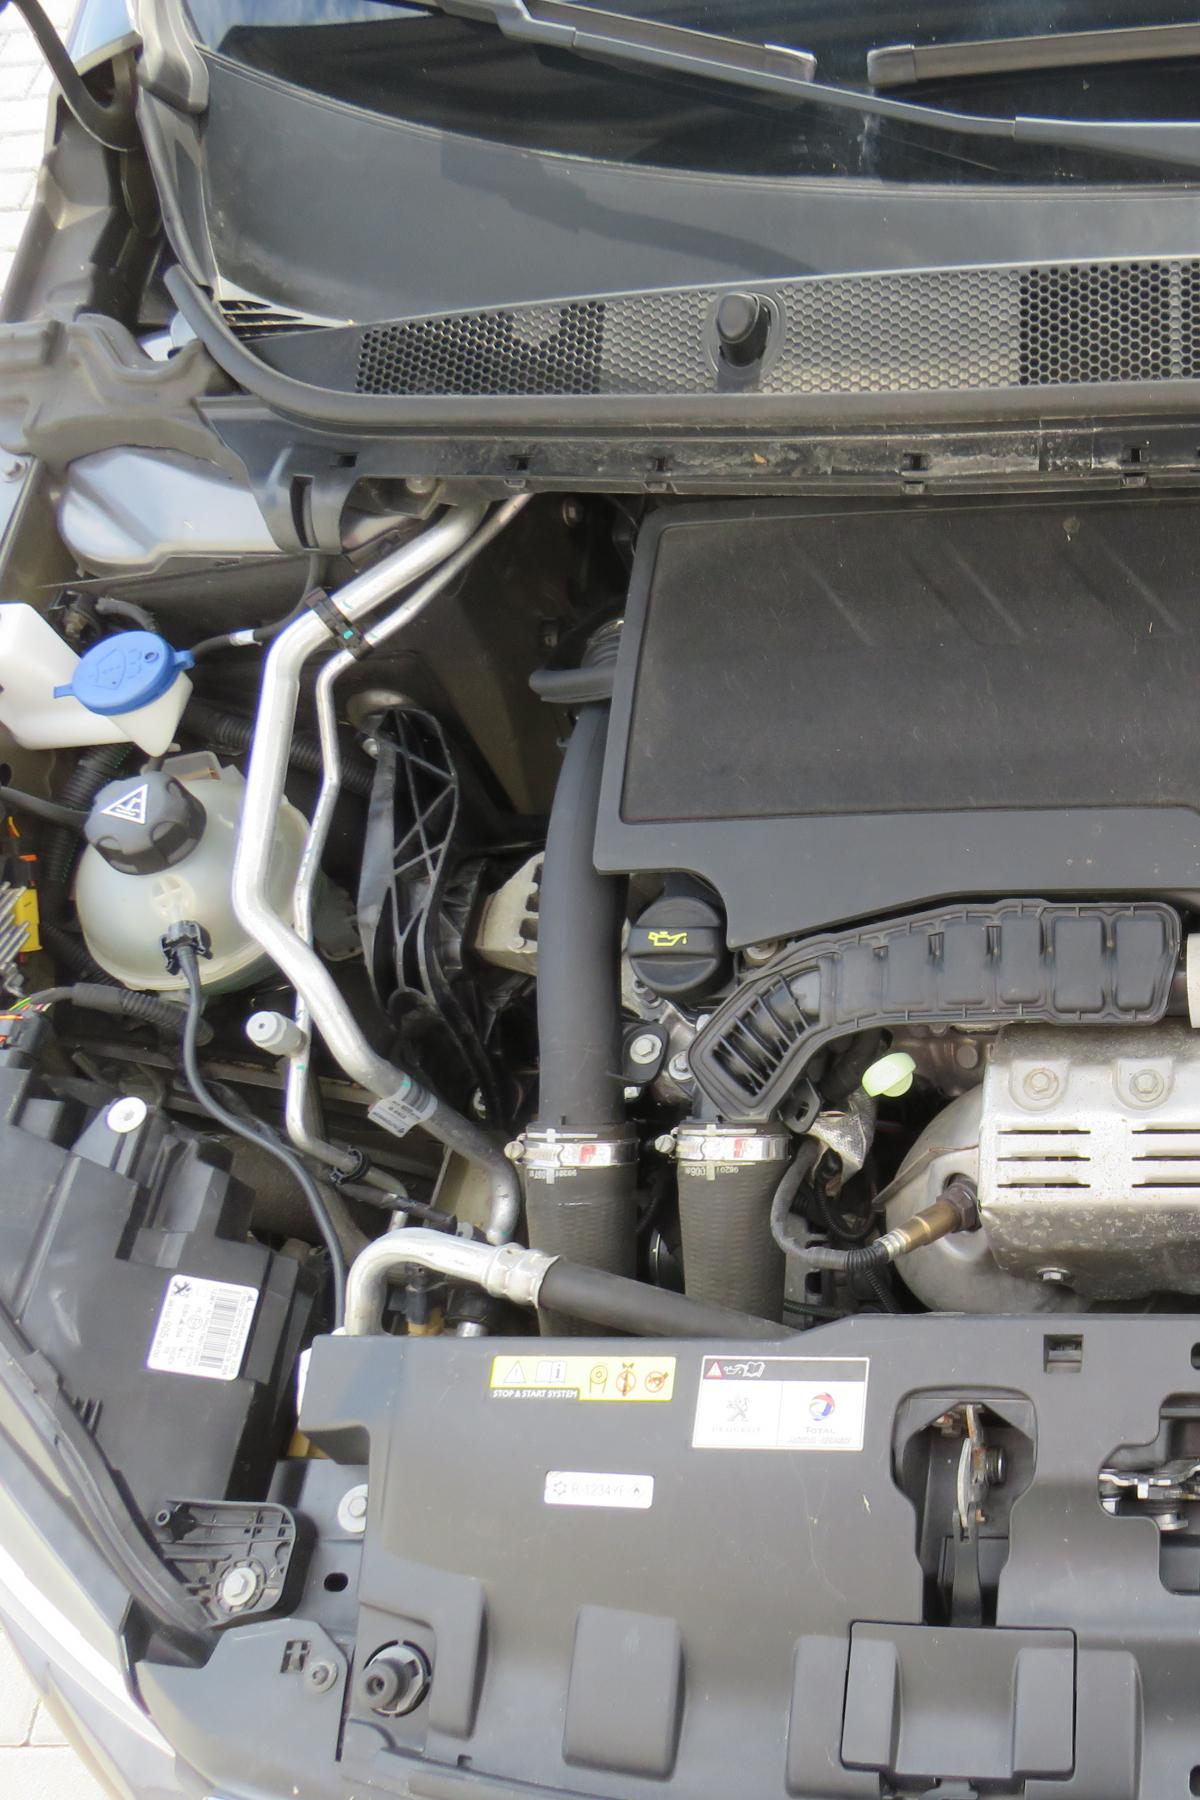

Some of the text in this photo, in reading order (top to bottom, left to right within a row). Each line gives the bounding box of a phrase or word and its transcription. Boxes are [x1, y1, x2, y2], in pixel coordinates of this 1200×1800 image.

[493, 1390, 514, 1398] STOP
[522, 1390, 546, 1398] START
[547, 1391, 577, 1399] SYSTEM
[804, 1426, 835, 1434] TOTAL
